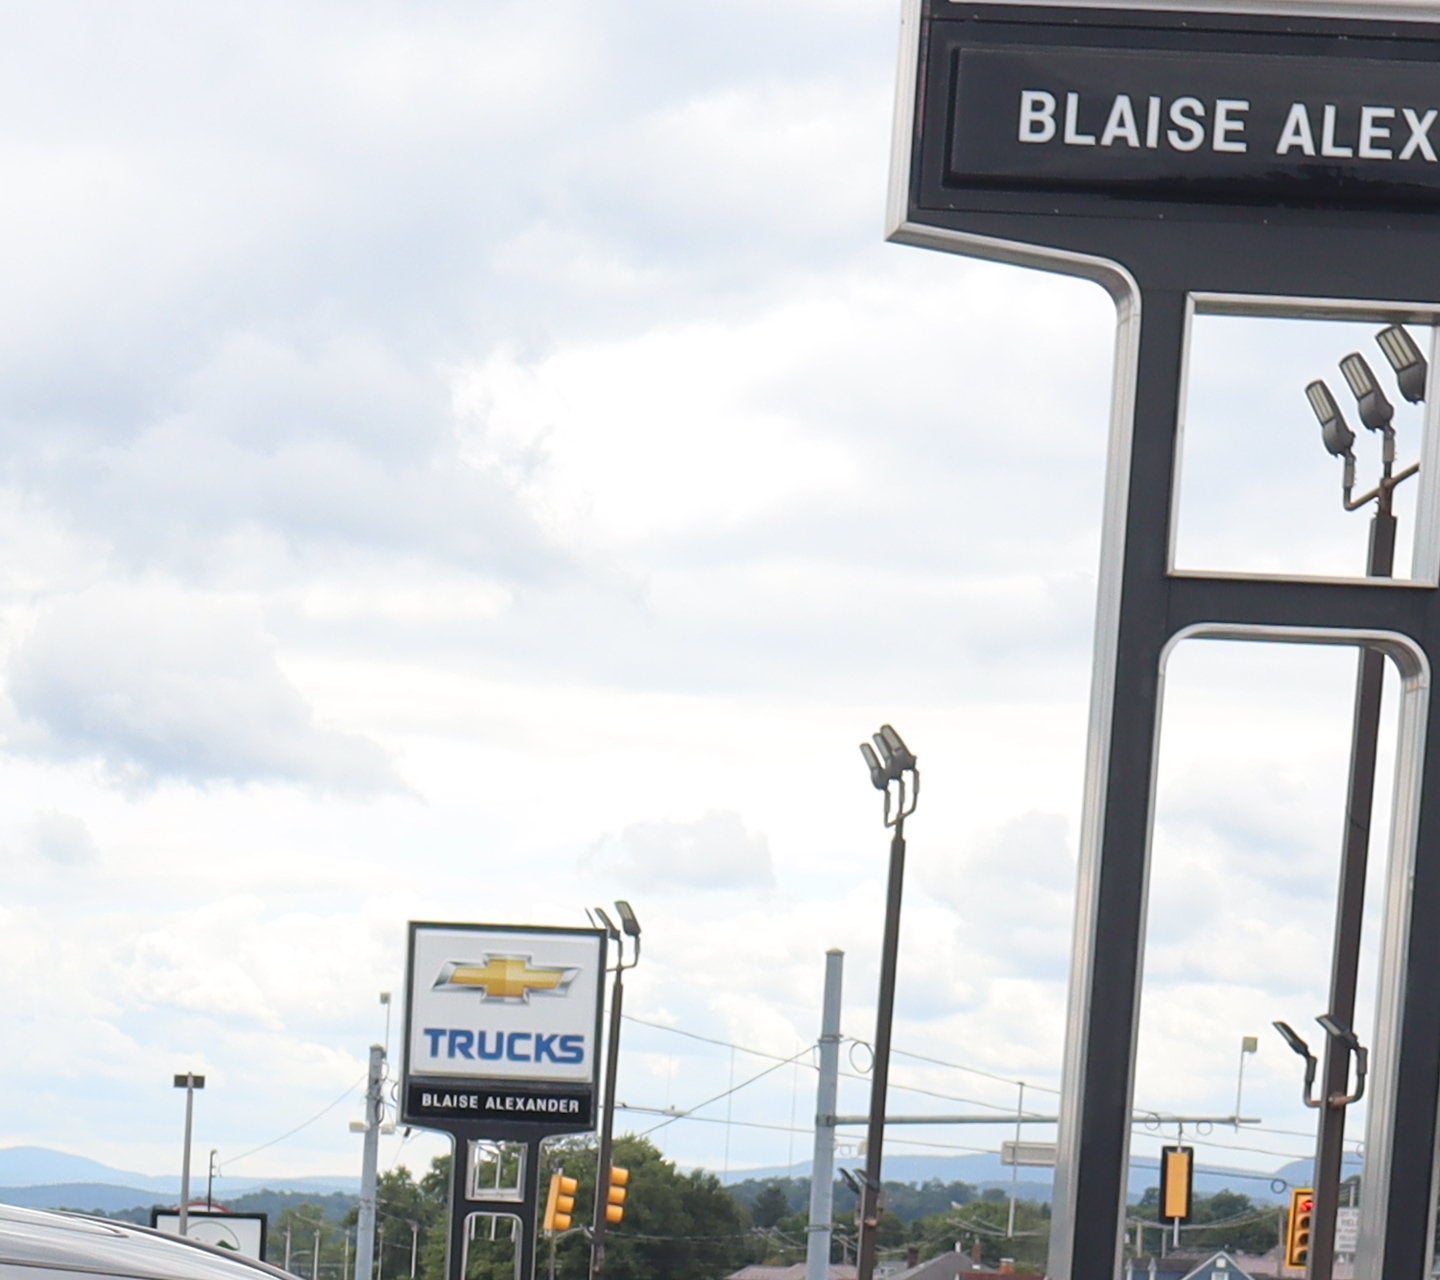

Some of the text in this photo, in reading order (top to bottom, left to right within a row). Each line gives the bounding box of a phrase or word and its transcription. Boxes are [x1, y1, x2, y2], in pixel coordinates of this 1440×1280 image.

[1017, 89, 1250, 155] BLAISE
[423, 1028, 584, 1064] TRUCKS
[421, 1092, 580, 1114] BLAISE ALEXANDER
